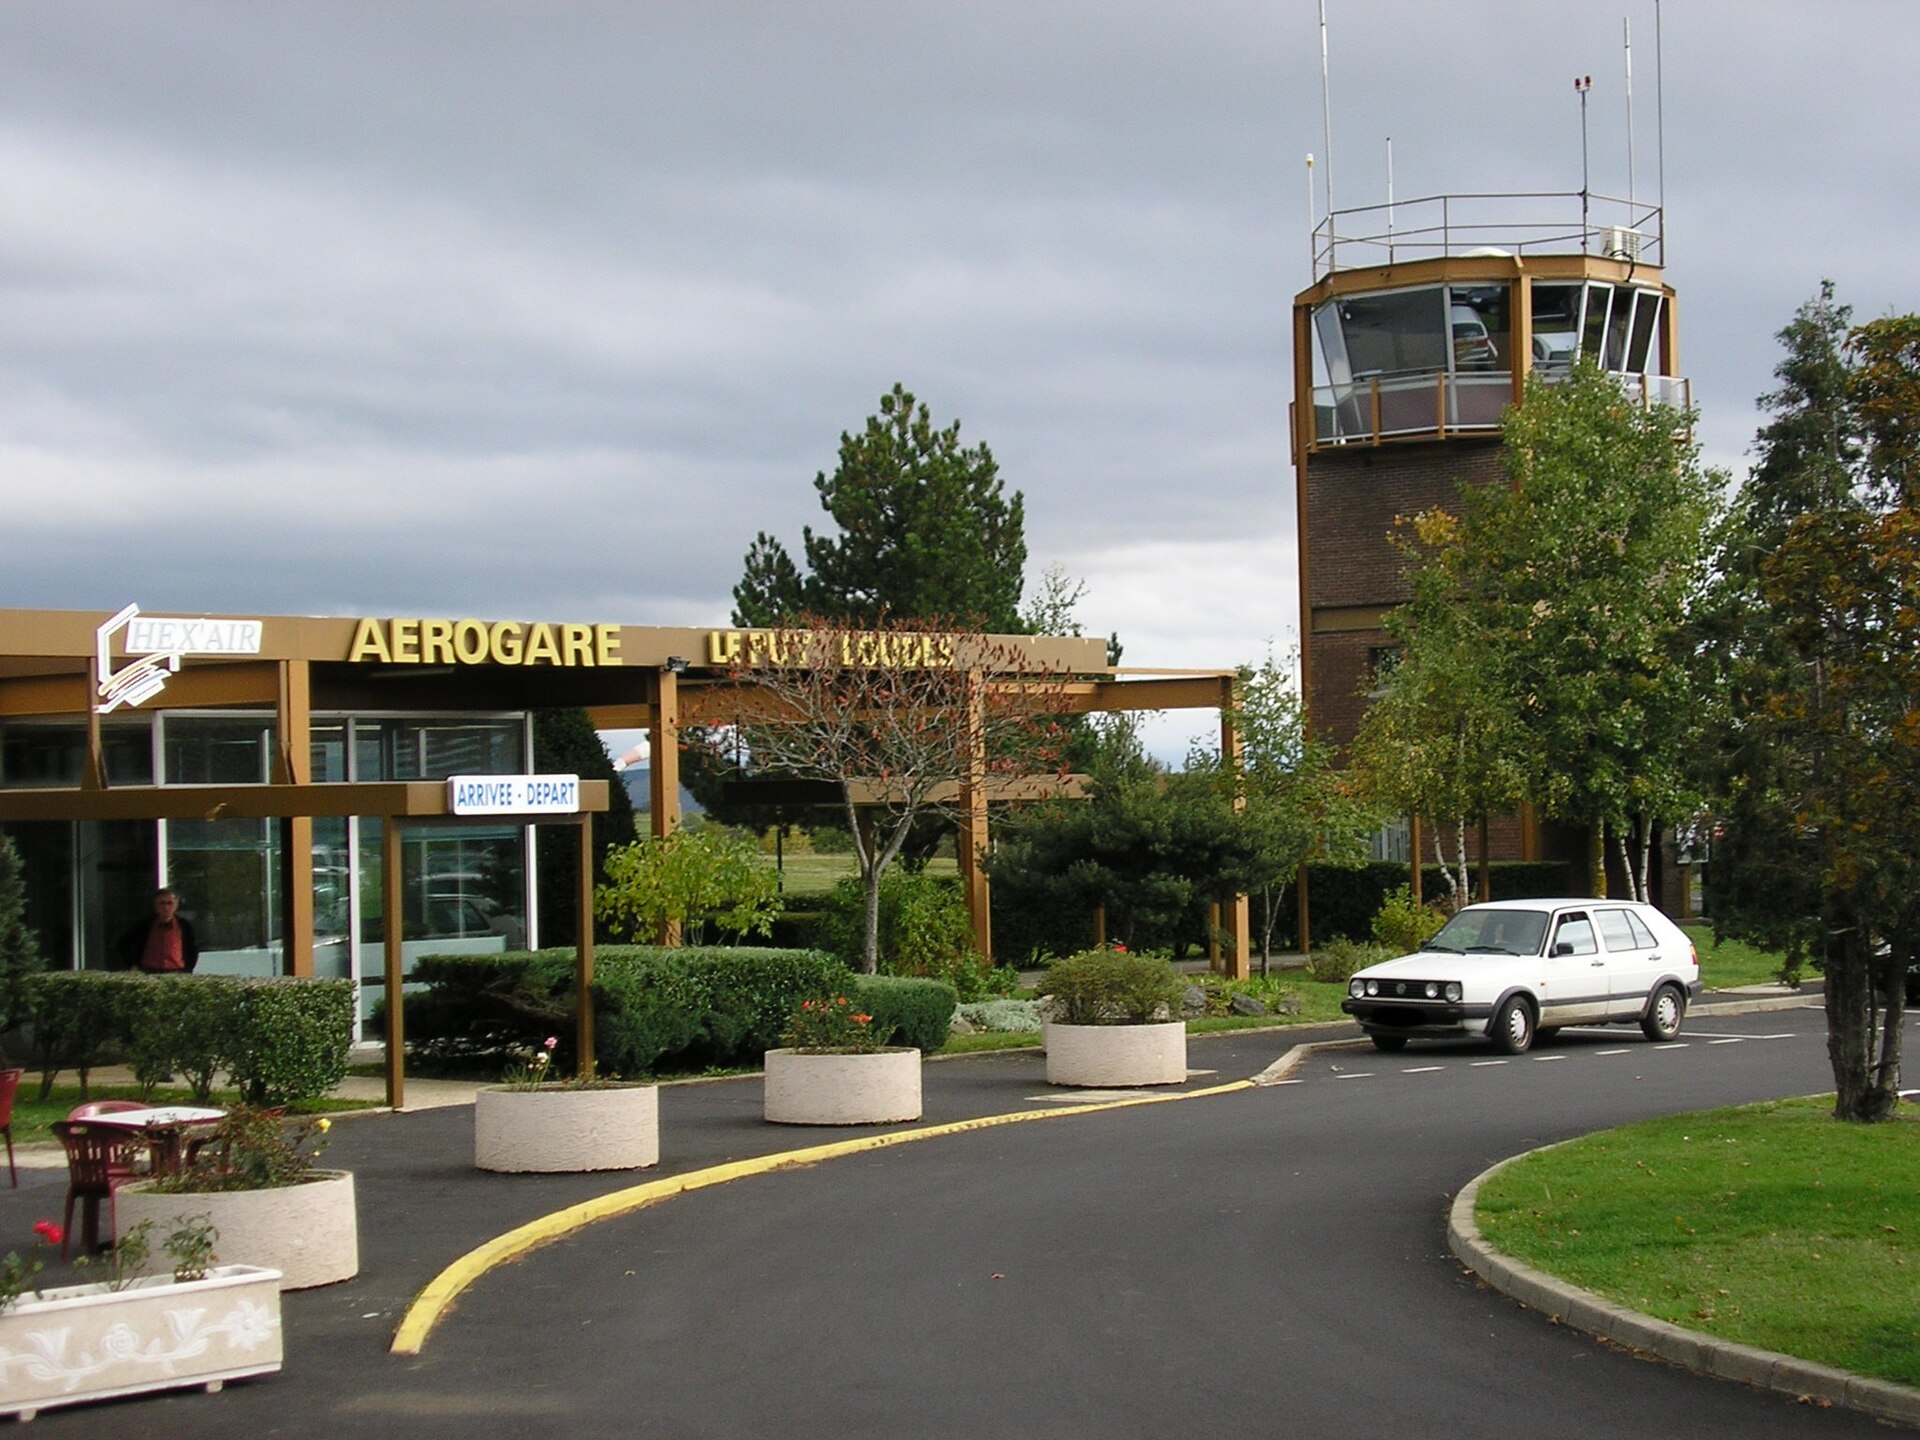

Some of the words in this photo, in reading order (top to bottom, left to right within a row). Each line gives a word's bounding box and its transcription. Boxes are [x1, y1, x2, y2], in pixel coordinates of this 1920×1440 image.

[131, 621, 257, 651] HEX'AIR
[349, 617, 623, 667] AEROGARE
[709, 631, 742, 664] LE
[457, 783, 512, 806] ARRIVEE
[527, 782, 575, 805] DEPART
